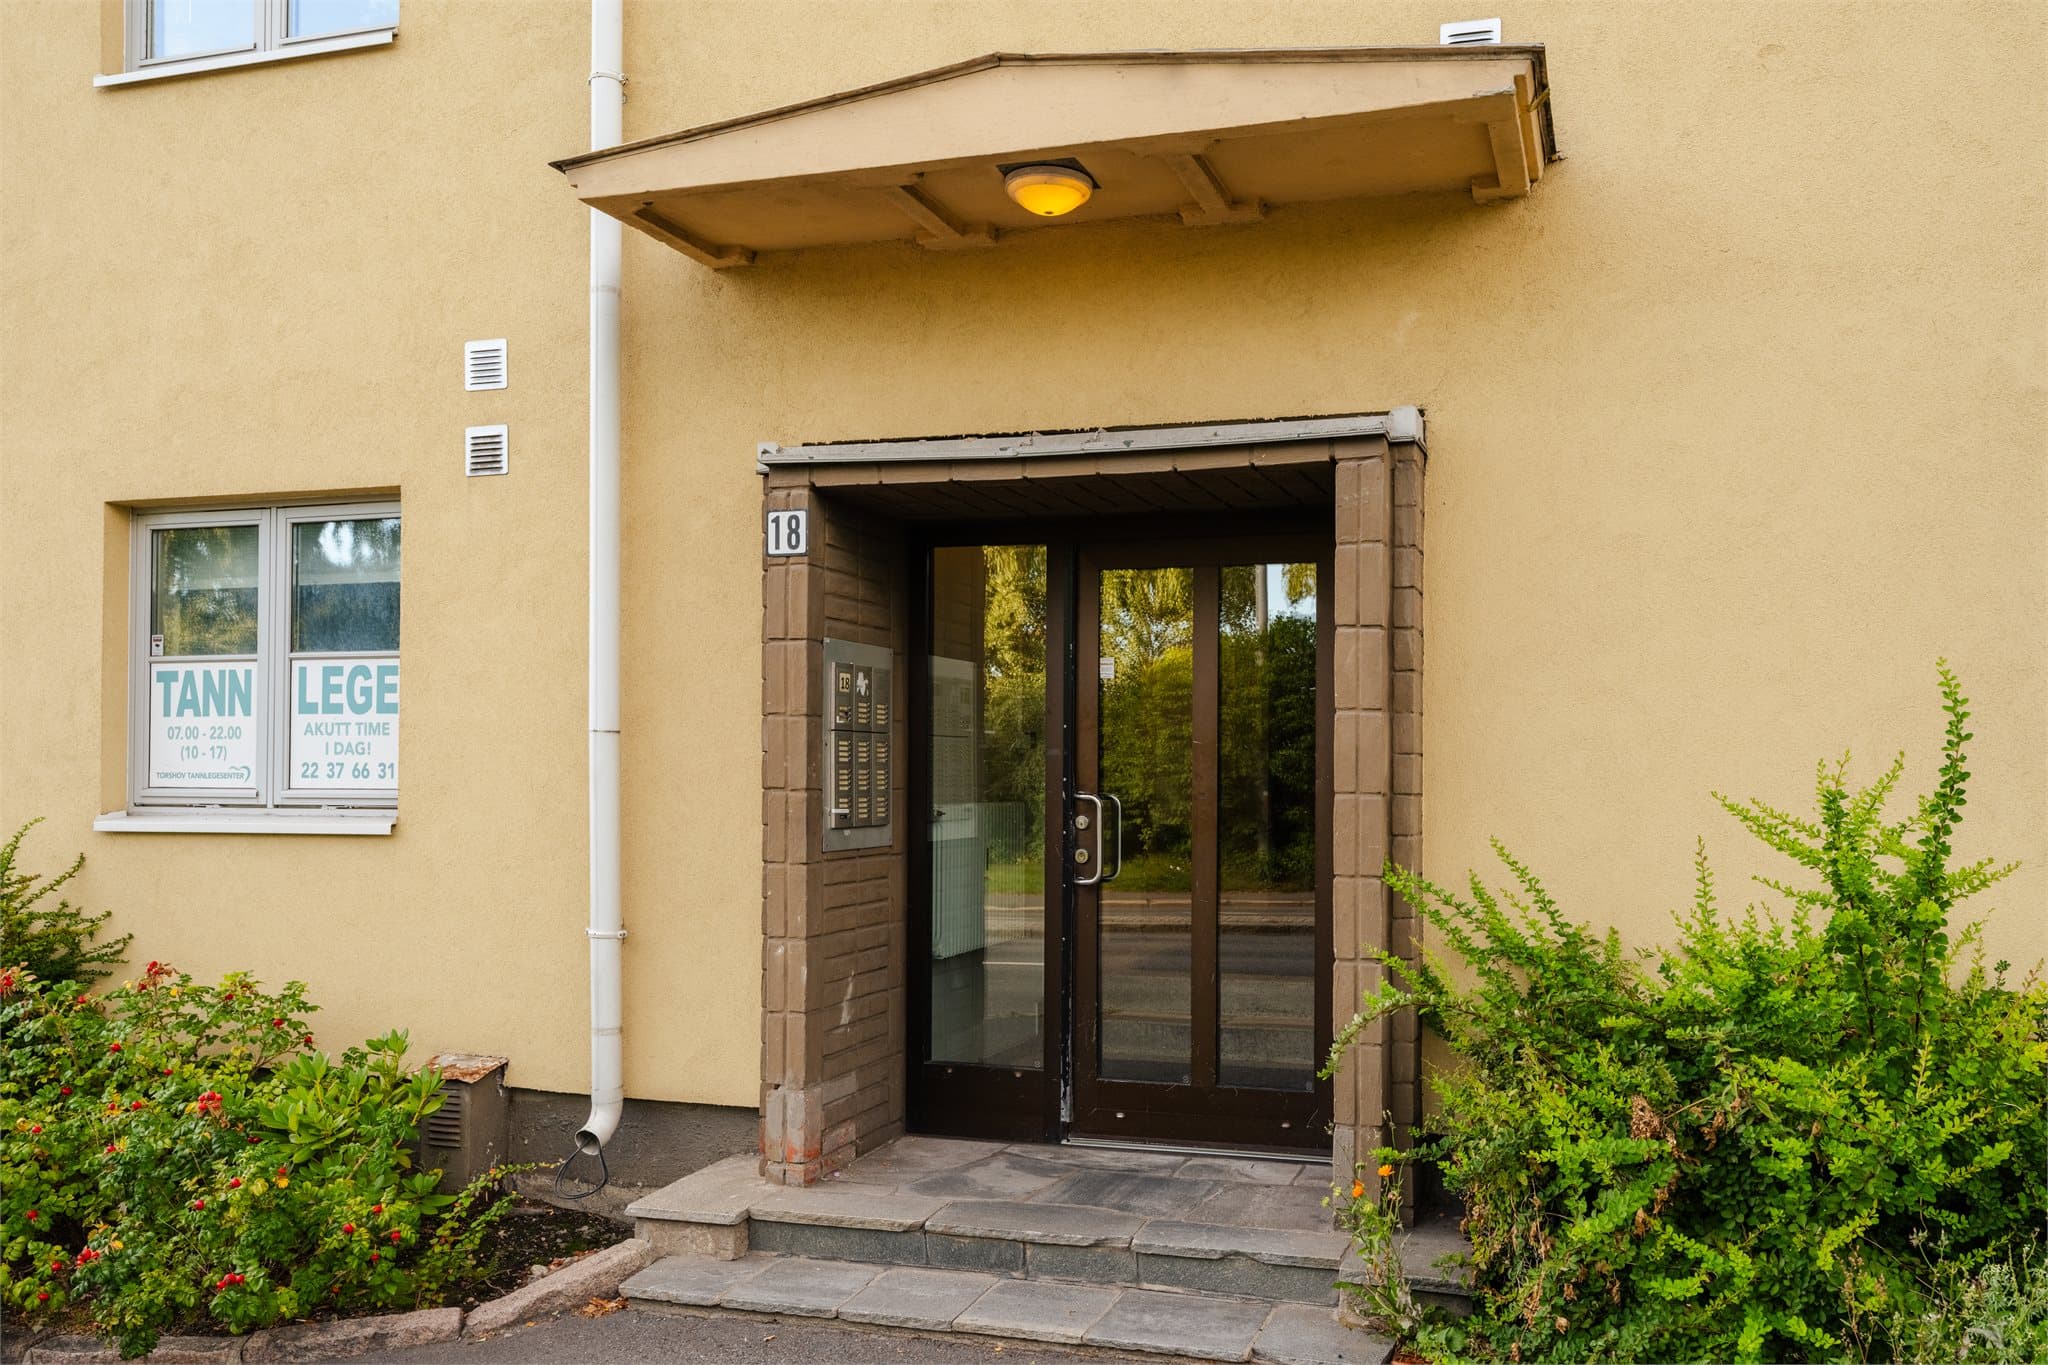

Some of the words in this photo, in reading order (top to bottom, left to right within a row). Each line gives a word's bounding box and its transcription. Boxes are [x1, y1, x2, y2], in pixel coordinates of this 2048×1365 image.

[770, 514, 801, 550] 18
[156, 669, 252, 717] TANN
[298, 665, 399, 715] LEGE
[841, 677, 850, 690] 18
[167, 726, 199, 741] 07.00
[209, 726, 242, 740] 22.00
[304, 722, 352, 736] AKUTT
[354, 722, 391, 736] TIME
[180, 745, 199, 761] (10
[209, 745, 227, 761] 17)
[325, 742, 329, 756] I
[333, 742, 371, 756] DAG!
[156, 772, 185, 780] TORSHOV
[187, 771, 245, 780] TANNLEGESENTER
[301, 763, 319, 779] 22
[327, 763, 345, 779] 37
[352, 763, 370, 779] 66
[378, 763, 395, 779] 31
